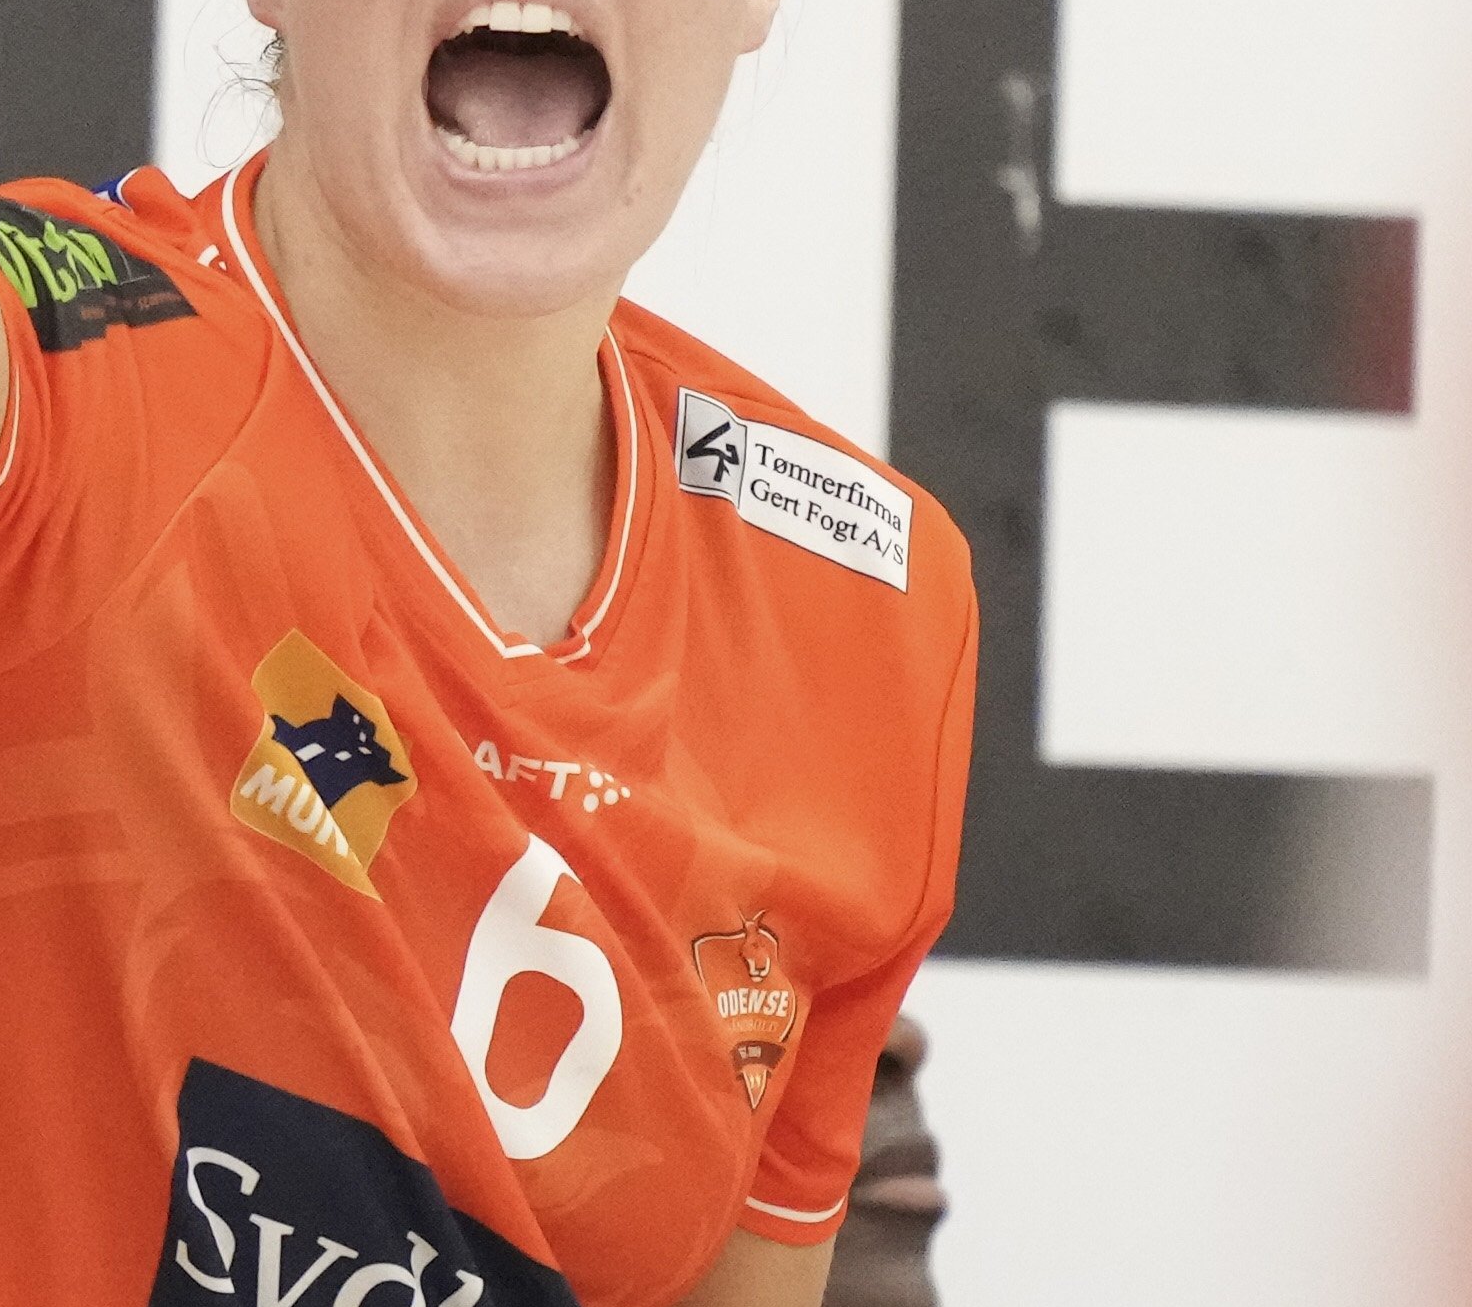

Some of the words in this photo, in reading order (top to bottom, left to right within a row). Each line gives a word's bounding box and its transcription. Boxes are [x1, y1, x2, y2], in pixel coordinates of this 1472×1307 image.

[749, 479, 800, 518] Gert
[805, 501, 859, 543] Fogt
[862, 528, 905, 566] A/S
[754, 443, 903, 532] Tømrerfirma
[450, 831, 624, 1160] 6
[717, 987, 790, 1019] ODENSE
